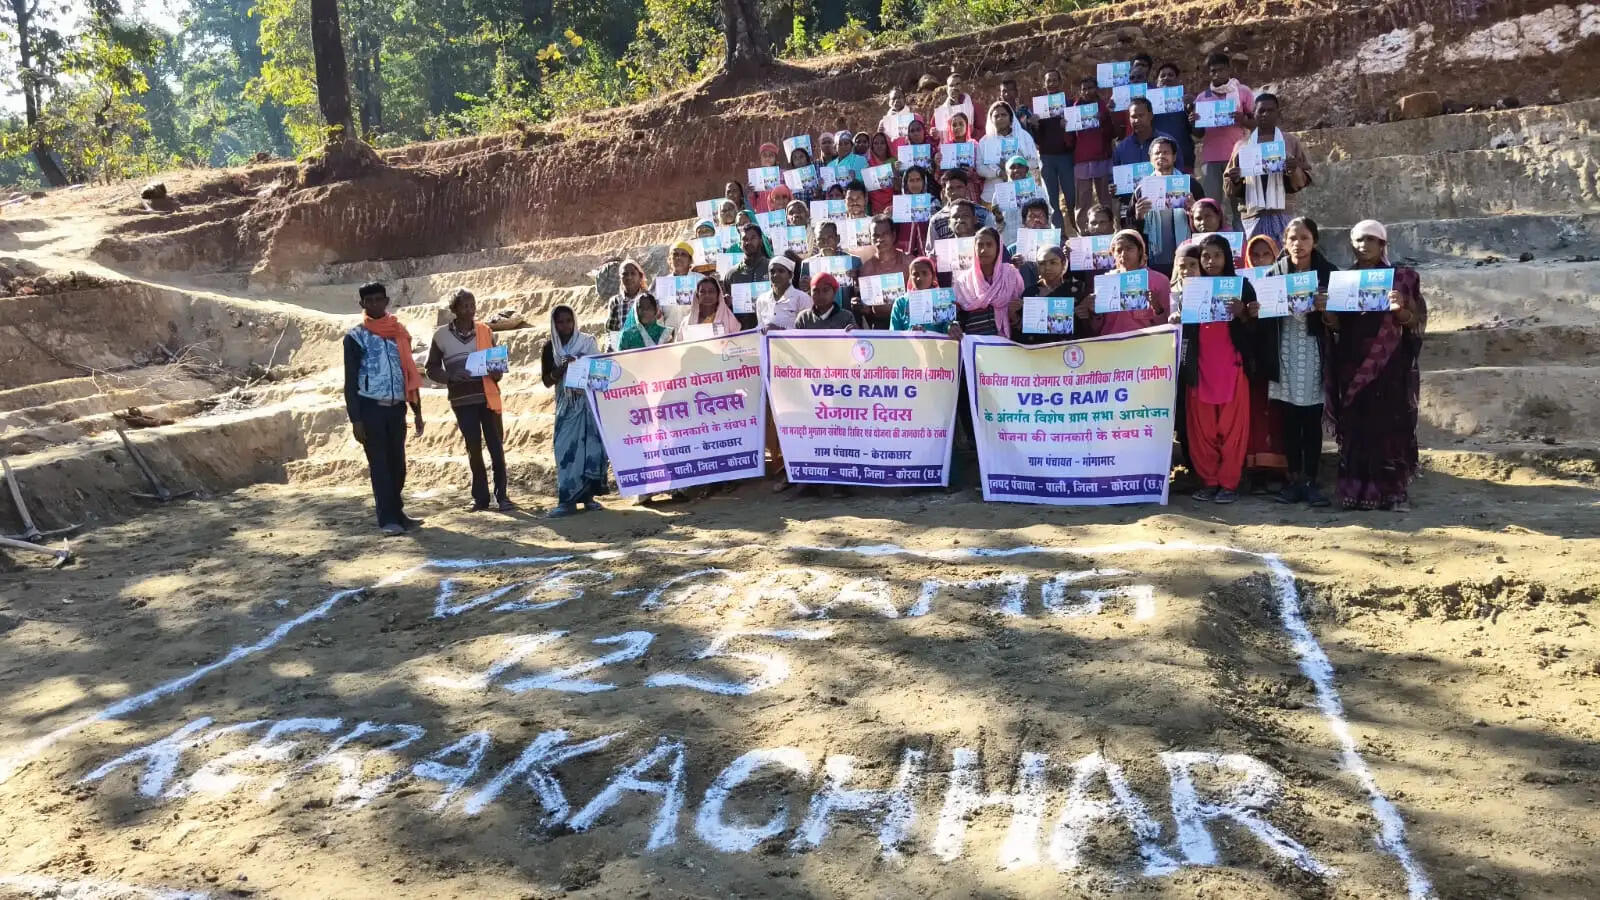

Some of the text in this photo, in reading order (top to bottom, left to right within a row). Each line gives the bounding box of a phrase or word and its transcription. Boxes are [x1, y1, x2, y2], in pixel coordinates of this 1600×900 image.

[1126, 274, 1141, 283] 125
[1293, 275, 1309, 286] 125
[1368, 271, 1384, 280] 125
[1220, 280, 1234, 289] 125
[1054, 300, 1067, 308] 125
[652, 377, 687, 393] आवास
[691, 372, 723, 388] योजना
[979, 372, 1008, 386] विकसित
[1011, 375, 1030, 387] भारत
[1033, 373, 1060, 387] रोजगार
[1063, 370, 1073, 386] एवं
[810, 384, 917, 398] VB-G RAM G
[1018, 388, 1128, 406] VB-G RAM G
[630, 391, 745, 426] आवास दिवस
[815, 402, 912, 422] रोजगार दिवस
[984, 405, 1170, 424] के अंतर्गत विशेष ग्राम सभा आयोजन
[624, 432, 652, 446] योजना
[655, 429, 668, 442] की
[670, 424, 709, 440] जानकारी
[712, 421, 721, 432] के
[998, 429, 1027, 442] योजना
[1032, 429, 1046, 443] की
[1051, 429, 1093, 442] जानकारी
[1097, 428, 1109, 441] के
[1144, 424, 1153, 438] में
[643, 448, 660, 460] ग्राम
[662, 441, 692, 456] पंचायत
[814, 448, 830, 457] ग्राम
[833, 445, 860, 458] पंचायत
[1028, 456, 1043, 467] ग्राम
[1046, 454, 1072, 467] पंचायत
[640, 467, 665, 480] पंचायत
[698, 460, 718, 472] जिला
[803, 464, 829, 477] पंचायत
[839, 467, 862, 480] पाली,
[864, 468, 885, 479] जिला
[896, 468, 920, 480] कोरबा
[1011, 476, 1036, 491] पंचायत
[1046, 480, 1071, 495] पाली,
[1073, 481, 1098, 493] जिला
[1110, 479, 1139, 491] कोरबा
